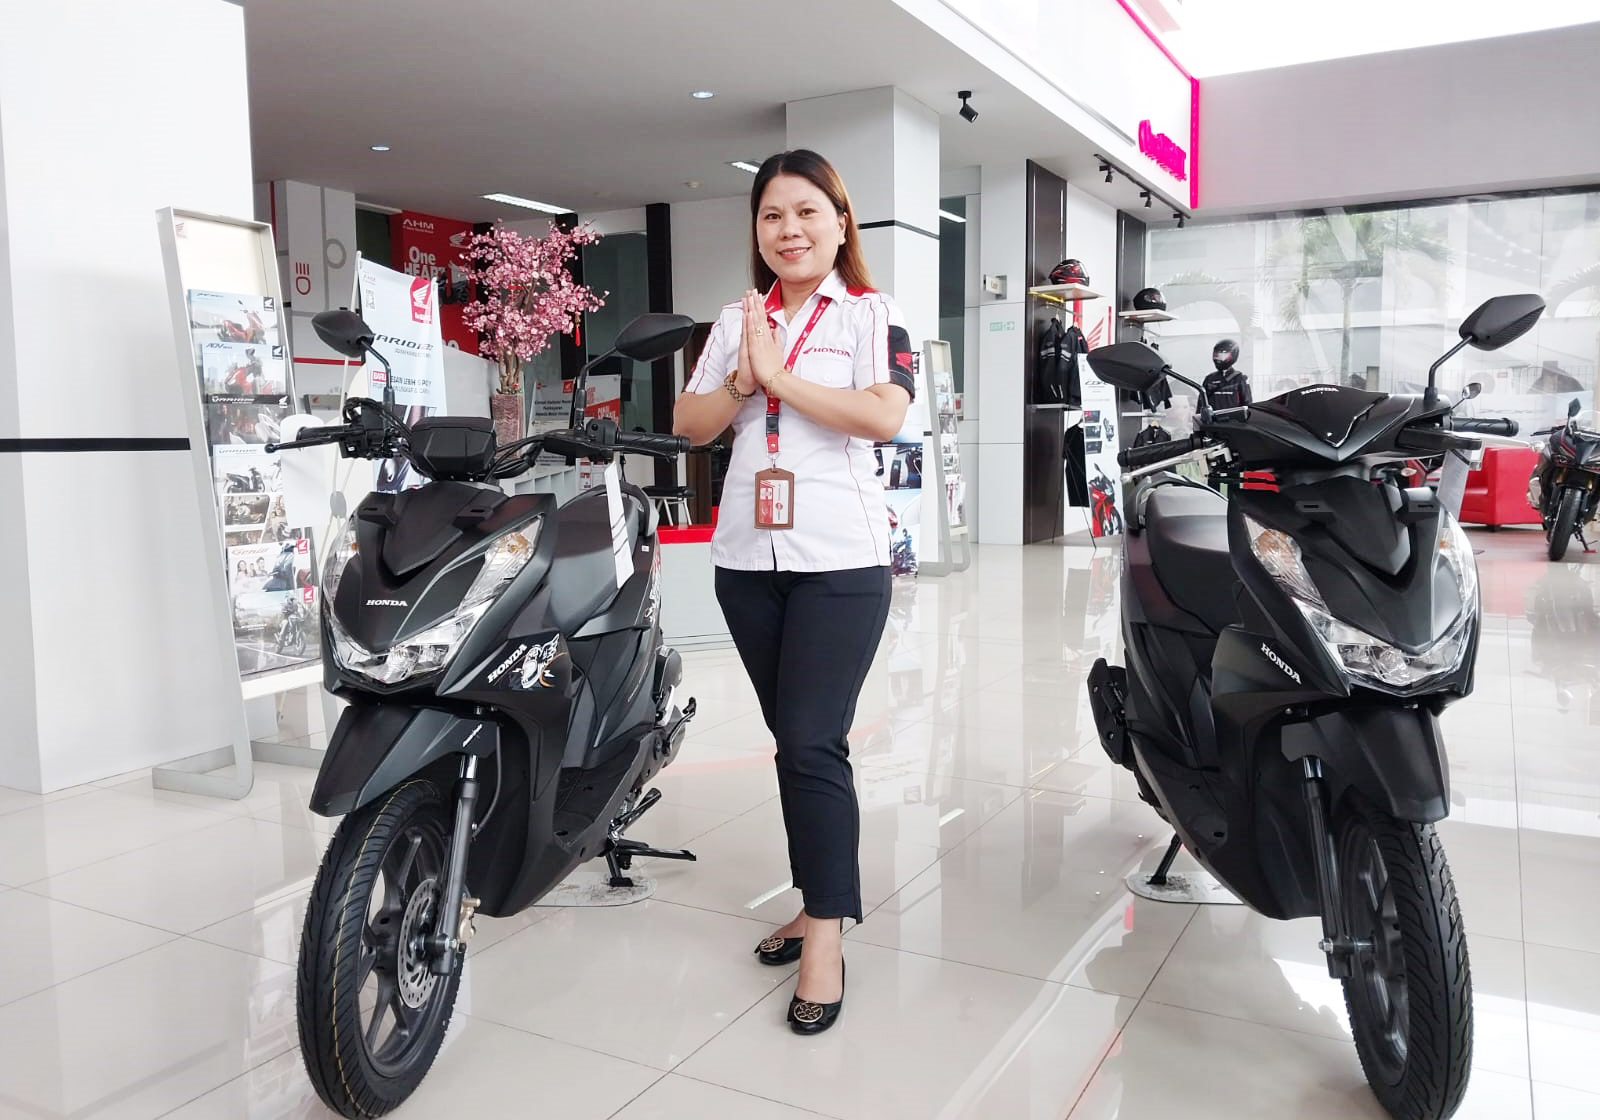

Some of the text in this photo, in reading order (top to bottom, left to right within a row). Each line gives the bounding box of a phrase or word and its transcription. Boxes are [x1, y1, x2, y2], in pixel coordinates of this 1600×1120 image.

[403, 218, 434, 230] AHM
[408, 246, 436, 266] One
[374, 333, 416, 349] ARIO
[813, 347, 852, 358] HONDA
[1301, 388, 1339, 396] HONDA
[366, 599, 408, 607] HONDA
[487, 643, 528, 684] HONDA
[1260, 642, 1302, 685] HONDA
